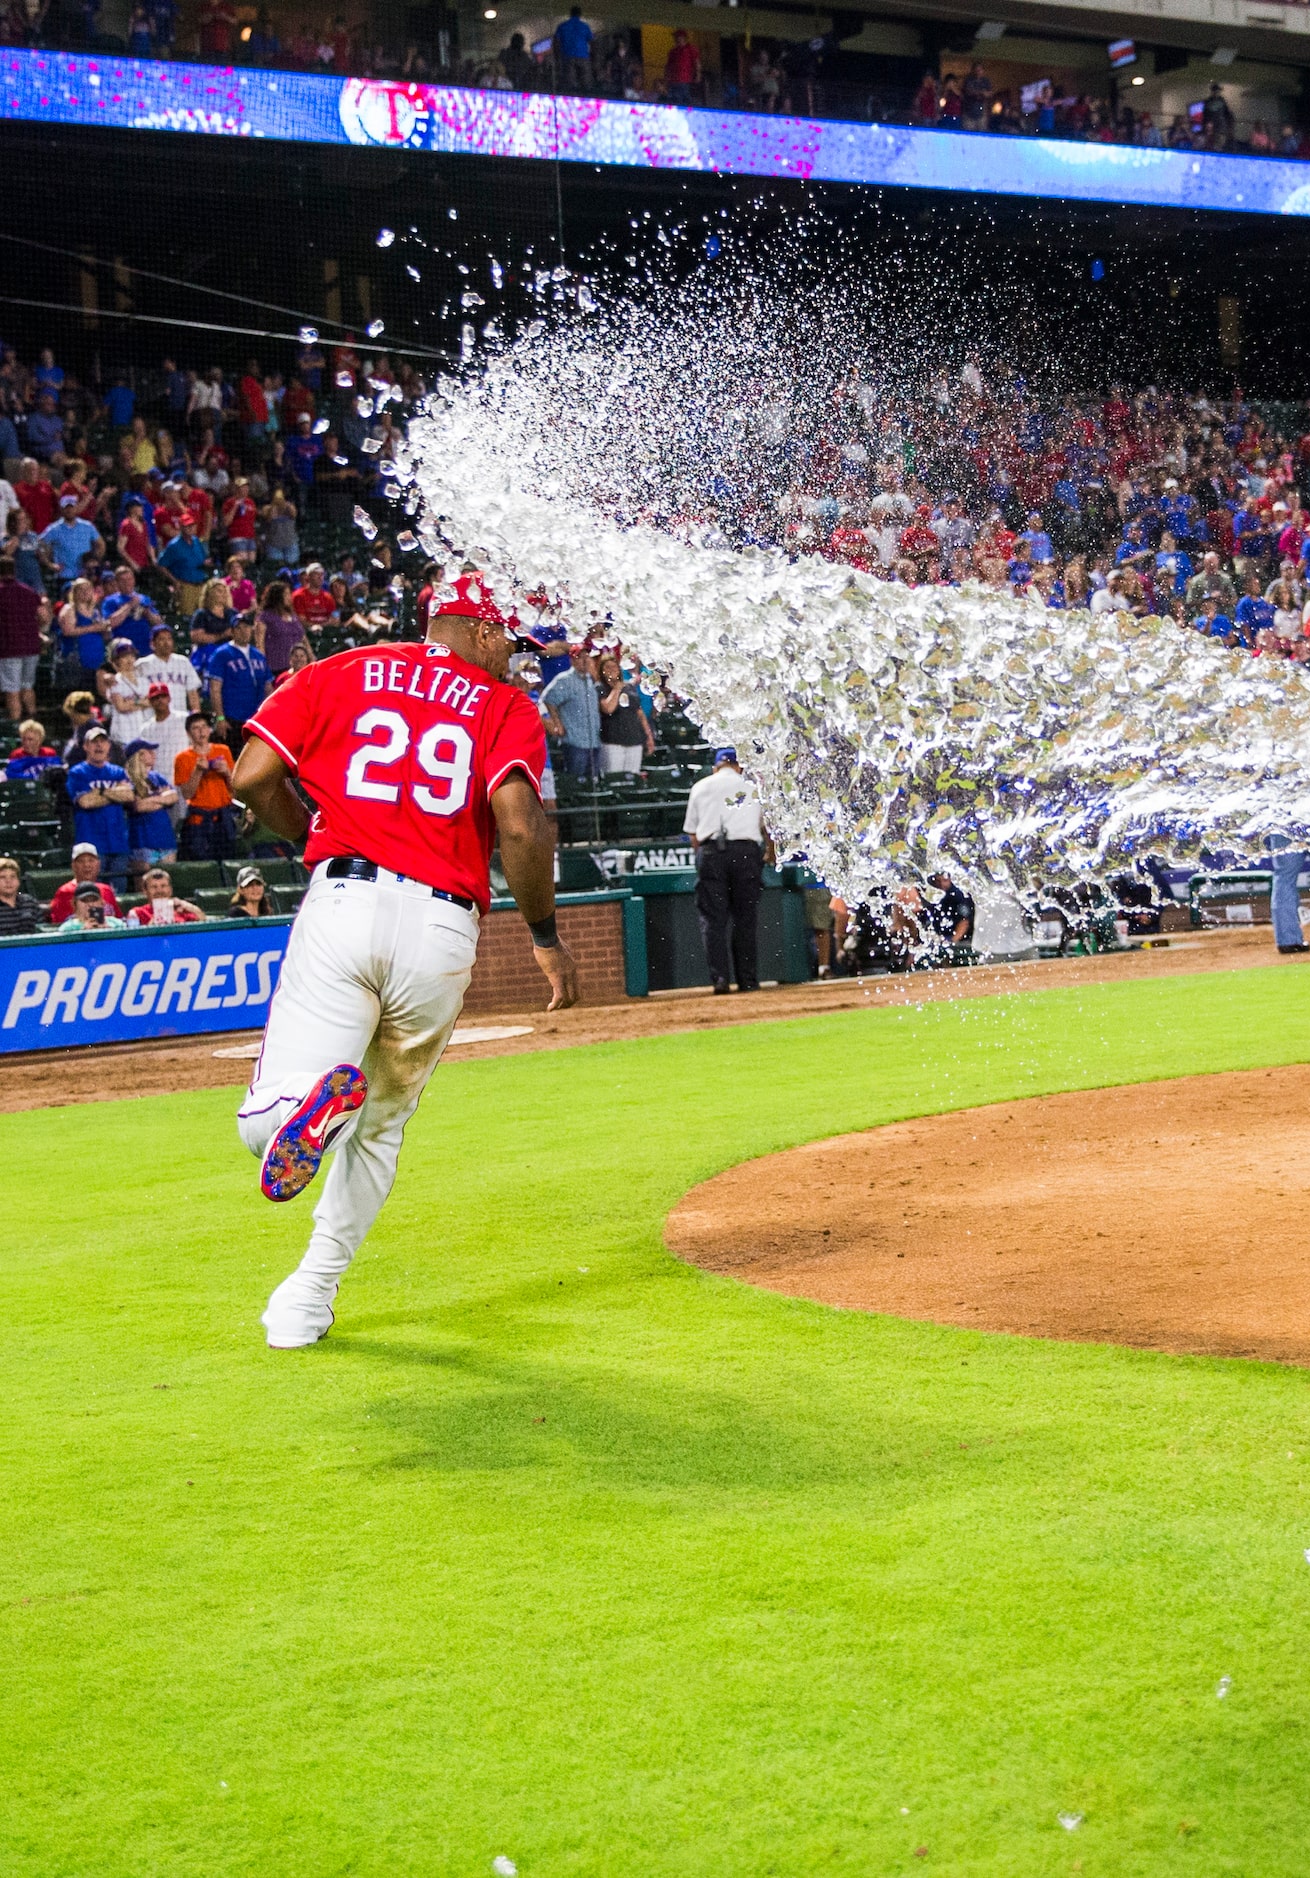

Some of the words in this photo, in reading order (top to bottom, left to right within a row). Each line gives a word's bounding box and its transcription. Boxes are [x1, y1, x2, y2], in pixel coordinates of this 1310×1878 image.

[363, 659, 490, 717] BELTRE
[345, 706, 476, 818] 29
[633, 847, 696, 870] ANATI
[2, 950, 282, 1029] PROGRESS
